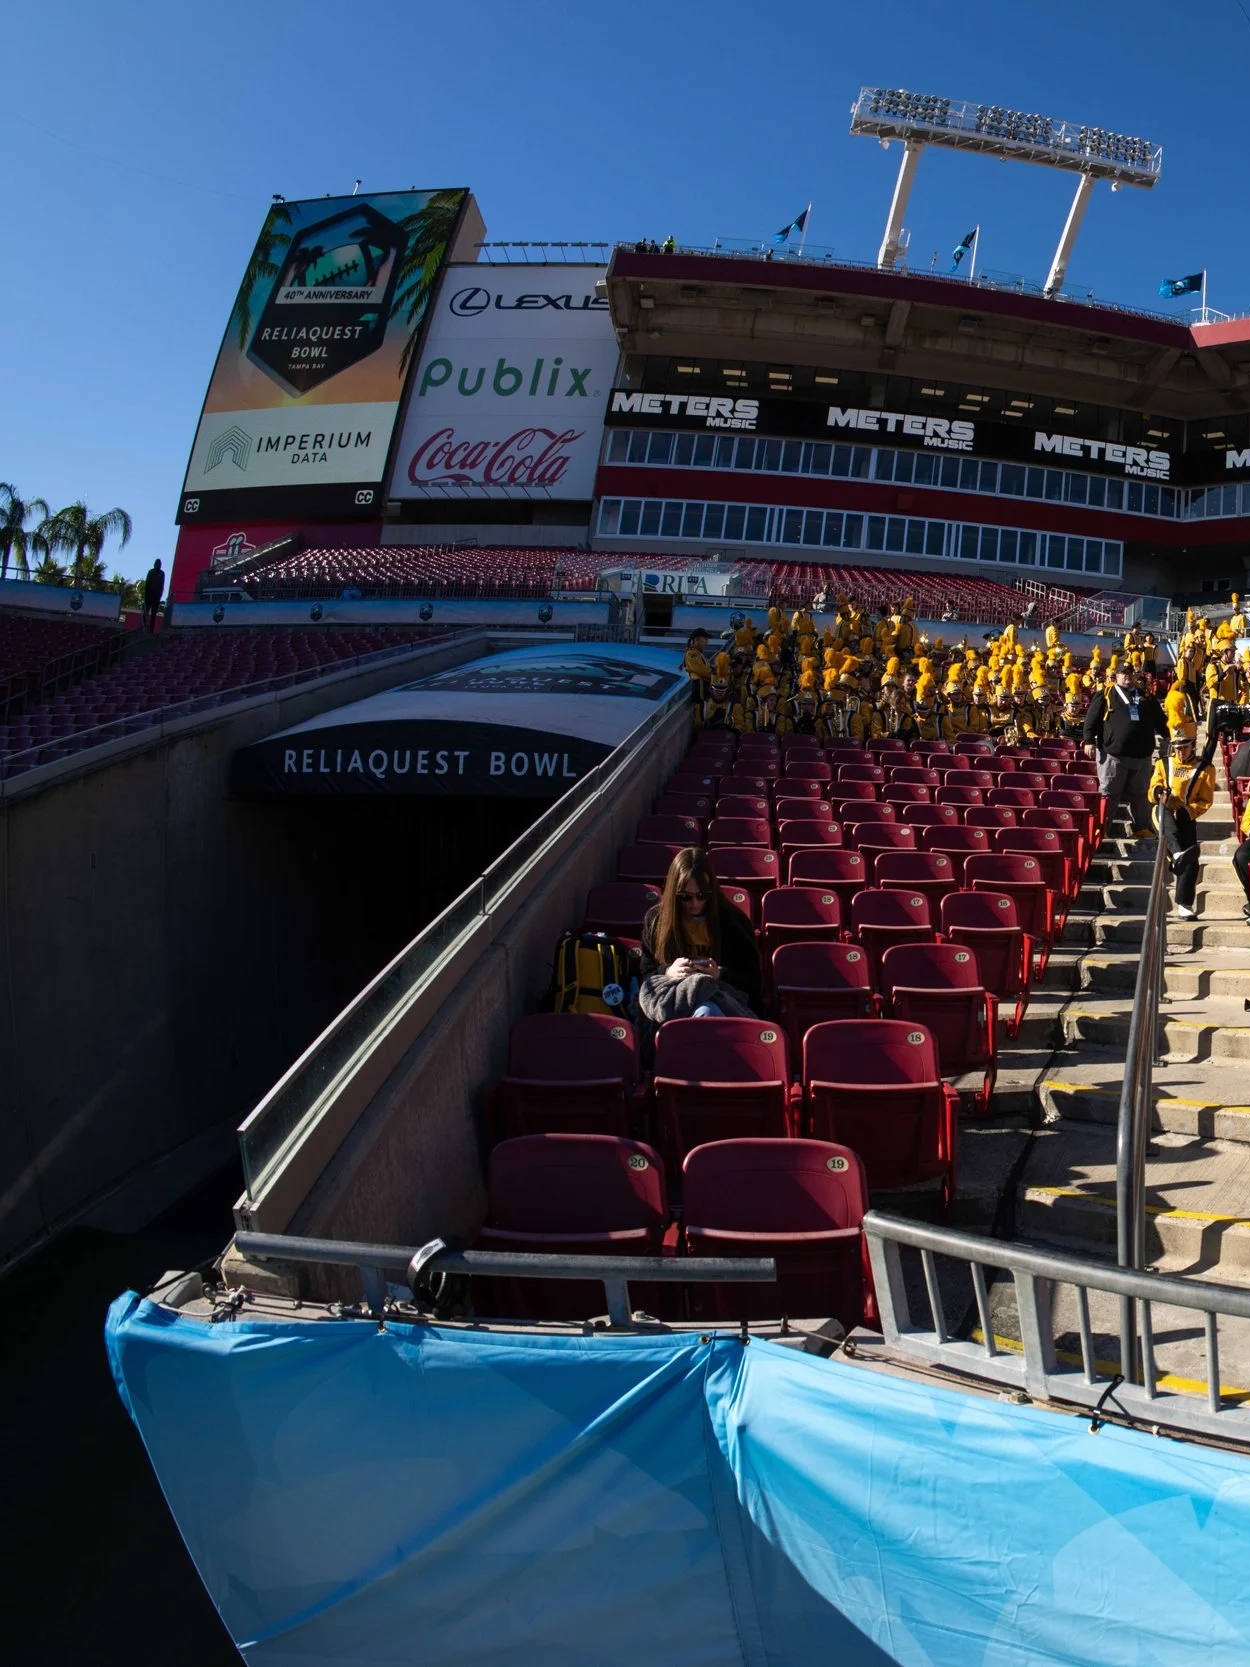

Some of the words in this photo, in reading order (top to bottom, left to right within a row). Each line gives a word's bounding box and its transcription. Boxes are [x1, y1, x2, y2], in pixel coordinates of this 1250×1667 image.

[304, 290, 373, 300] ANNIVERSARY
[495, 294, 609, 311] LEXUS
[262, 326, 363, 342] RELIAQUEST
[291, 347, 328, 358] BOWL
[418, 357, 592, 397] Publix
[611, 392, 759, 420] METERS
[706, 416, 757, 429] MUSIC
[827, 406, 974, 441] METERS
[256, 431, 372, 453] IMPERIUM
[924, 435, 973, 450] MUSIC
[408, 427, 586, 485] Coca-Cola
[1034, 432, 1170, 470] METERS
[291, 452, 327, 464] DATA
[1125, 463, 1170, 479] MUSIC
[356, 491, 372, 503] CC
[185, 500, 199, 512] CC
[284, 749, 470, 779] RELIAQUEST
[490, 751, 577, 777] BOWL
[957, 953, 967, 961] 17
[612, 1028, 624, 1039] 20
[763, 1032, 774, 1041] 19
[910, 1033, 922, 1042] 18
[630, 1157, 646, 1168] 20
[831, 1159, 845, 1169] 19
